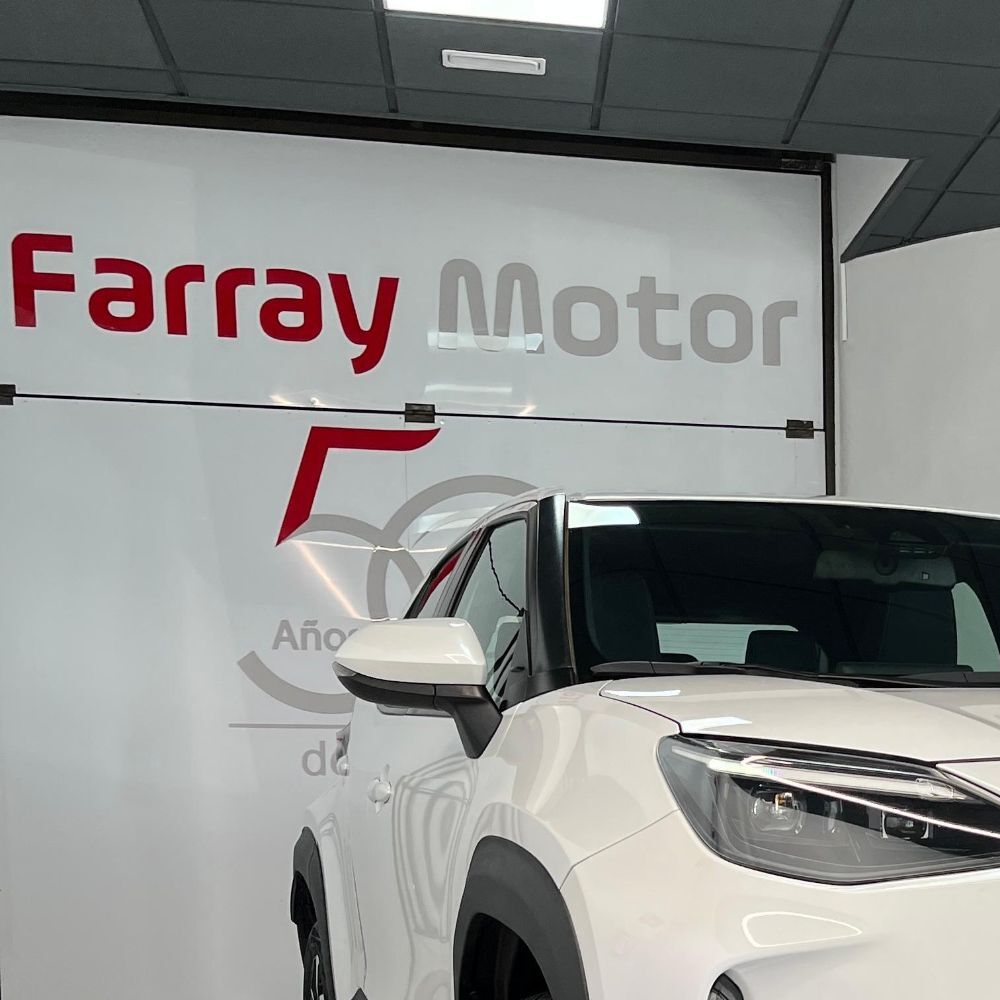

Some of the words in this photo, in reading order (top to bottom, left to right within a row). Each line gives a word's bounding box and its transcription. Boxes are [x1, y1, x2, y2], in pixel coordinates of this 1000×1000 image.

[11, 232, 400, 374] Farray
[438, 258, 798, 367] Motor
[272, 619, 357, 651] Año
